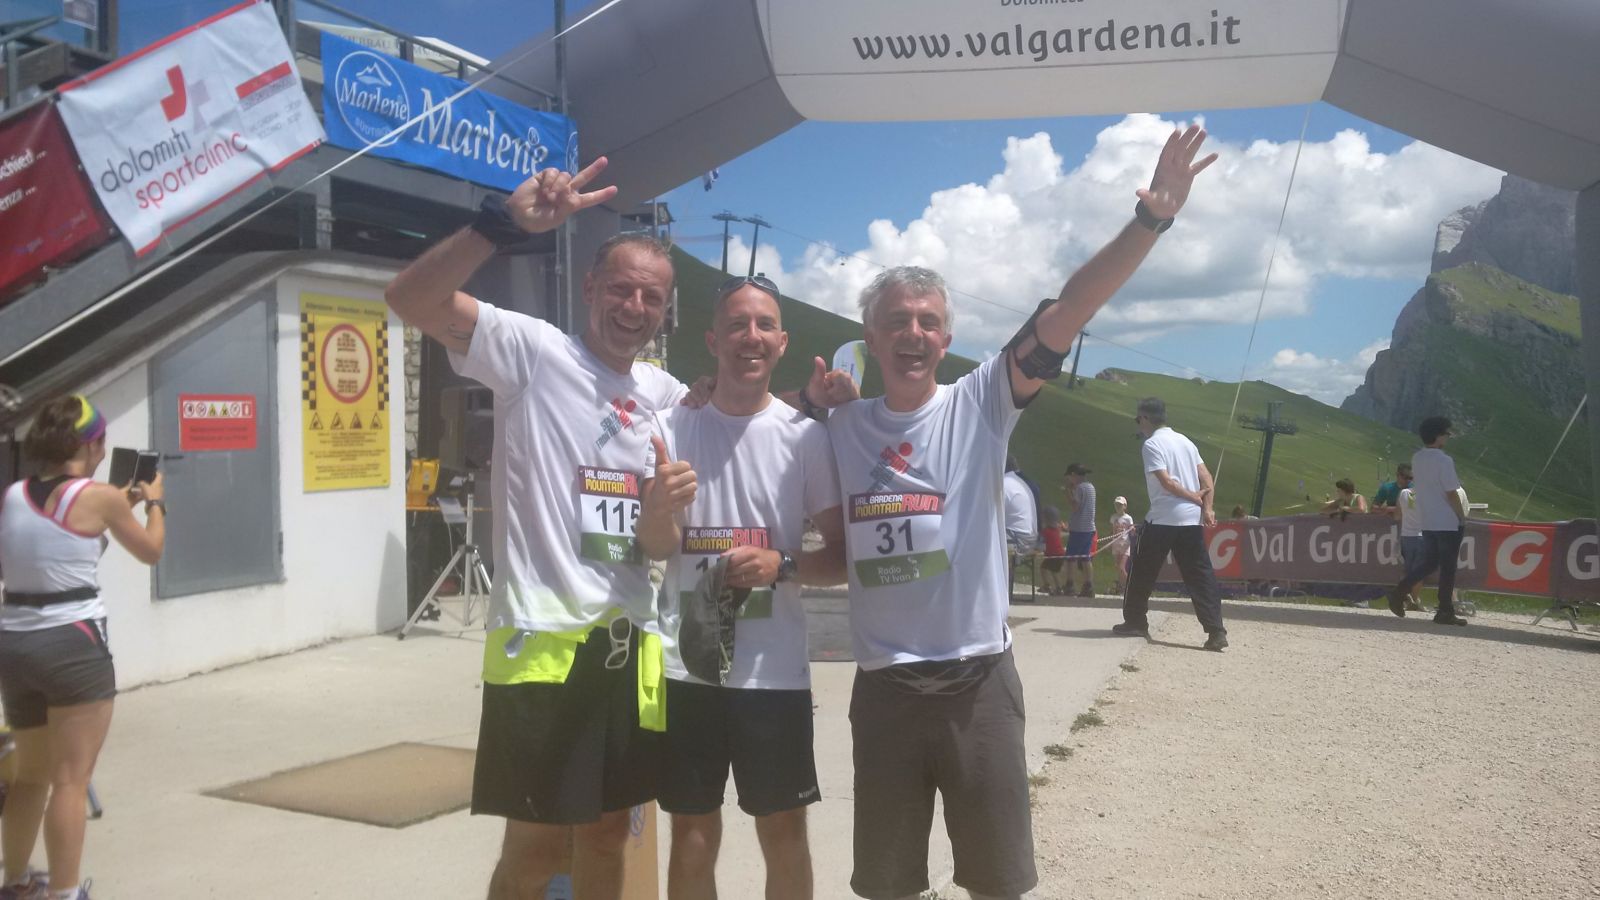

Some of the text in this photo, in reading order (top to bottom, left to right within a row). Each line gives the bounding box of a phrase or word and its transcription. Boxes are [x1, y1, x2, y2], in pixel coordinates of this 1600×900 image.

[852, 10, 1241, 62] www.valgardena.it
[339, 78, 407, 120] Marlene
[413, 87, 548, 176] Marlene
[101, 127, 191, 192] dolomiti
[136, 132, 247, 211] sportclinic
[584, 469, 625, 482] VAL GARDENA
[585, 479, 625, 494] MOUNTAIN
[855, 494, 903, 505] VAL GARDENA
[902, 494, 939, 513] RUN
[596, 499, 640, 535] 115
[855, 503, 902, 517] MOUNTAIN
[700, 529, 733, 538] GARDENA
[876, 519, 914, 555] 31
[686, 539, 733, 550] MOUNTAIN
[1249, 524, 1476, 571] Val Garda
[878, 566, 902, 576] Radio
[880, 574, 911, 585] TV Ivan
